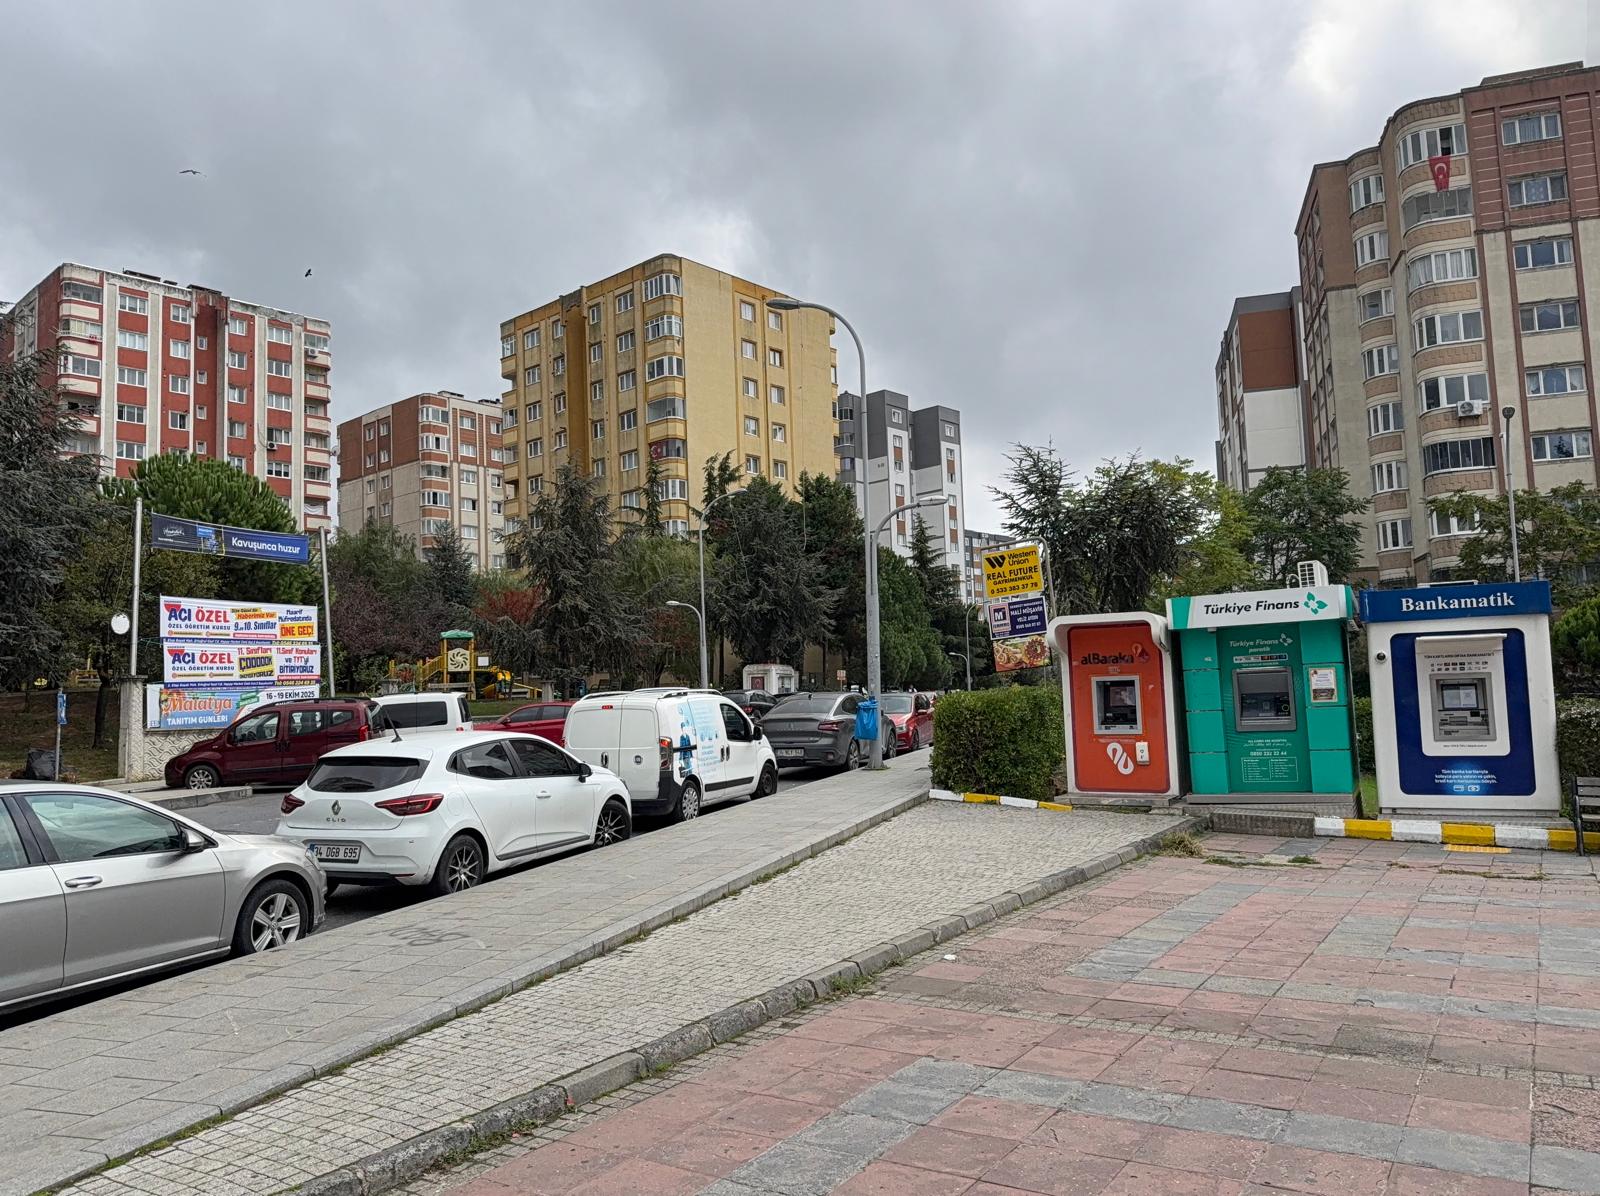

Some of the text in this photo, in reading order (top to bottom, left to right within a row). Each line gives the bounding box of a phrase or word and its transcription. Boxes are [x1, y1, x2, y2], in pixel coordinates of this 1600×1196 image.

[231, 537, 301, 554] Kavuşunca huzur
[1007, 550, 1036, 560] Western
[1008, 558, 1030, 566] Union
[987, 565, 1039, 581] REAL FUTURE
[1204, 600, 1300, 616] Türkiye Finans
[1400, 592, 1515, 612] Bankamatik
[167, 606, 230, 623] AÇI ÖZEL
[253, 621, 277, 631] Sınıflar
[281, 624, 296, 637] ÖNE
[1229, 638, 1279, 648] Türkiye Finans
[199, 650, 234, 664] ÖZEL
[285, 689, 300, 699] EKİM
[300, 690, 316, 698] 2025
[165, 695, 232, 716] Malatya
[167, 717, 198, 726] TANITIM
[343, 847, 358, 858] 695
